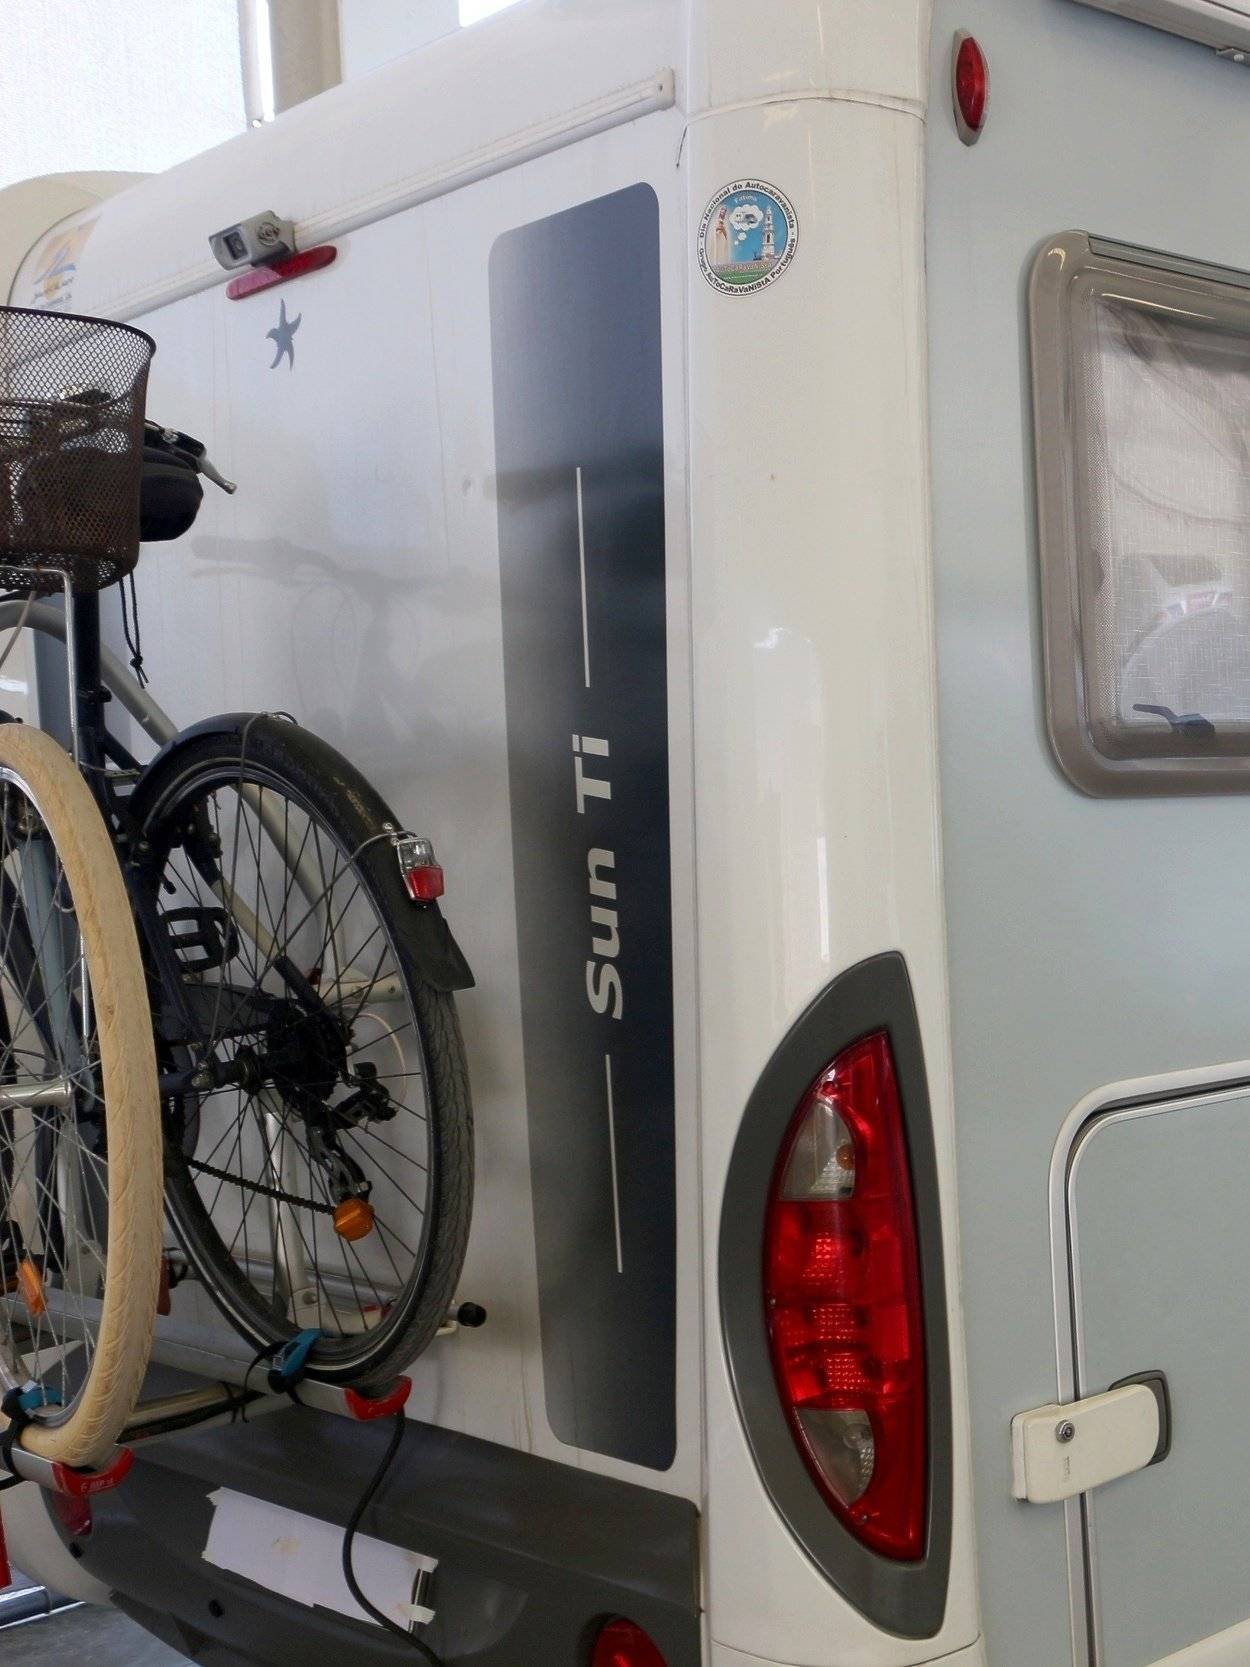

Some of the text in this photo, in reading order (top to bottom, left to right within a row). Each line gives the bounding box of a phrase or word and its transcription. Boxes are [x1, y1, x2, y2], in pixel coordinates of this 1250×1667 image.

[704, 188, 731, 221] Nacional
[732, 183, 743, 191] do
[745, 181, 795, 229] Autocaravanista
[571, 734, 624, 1020] Sun Ti
